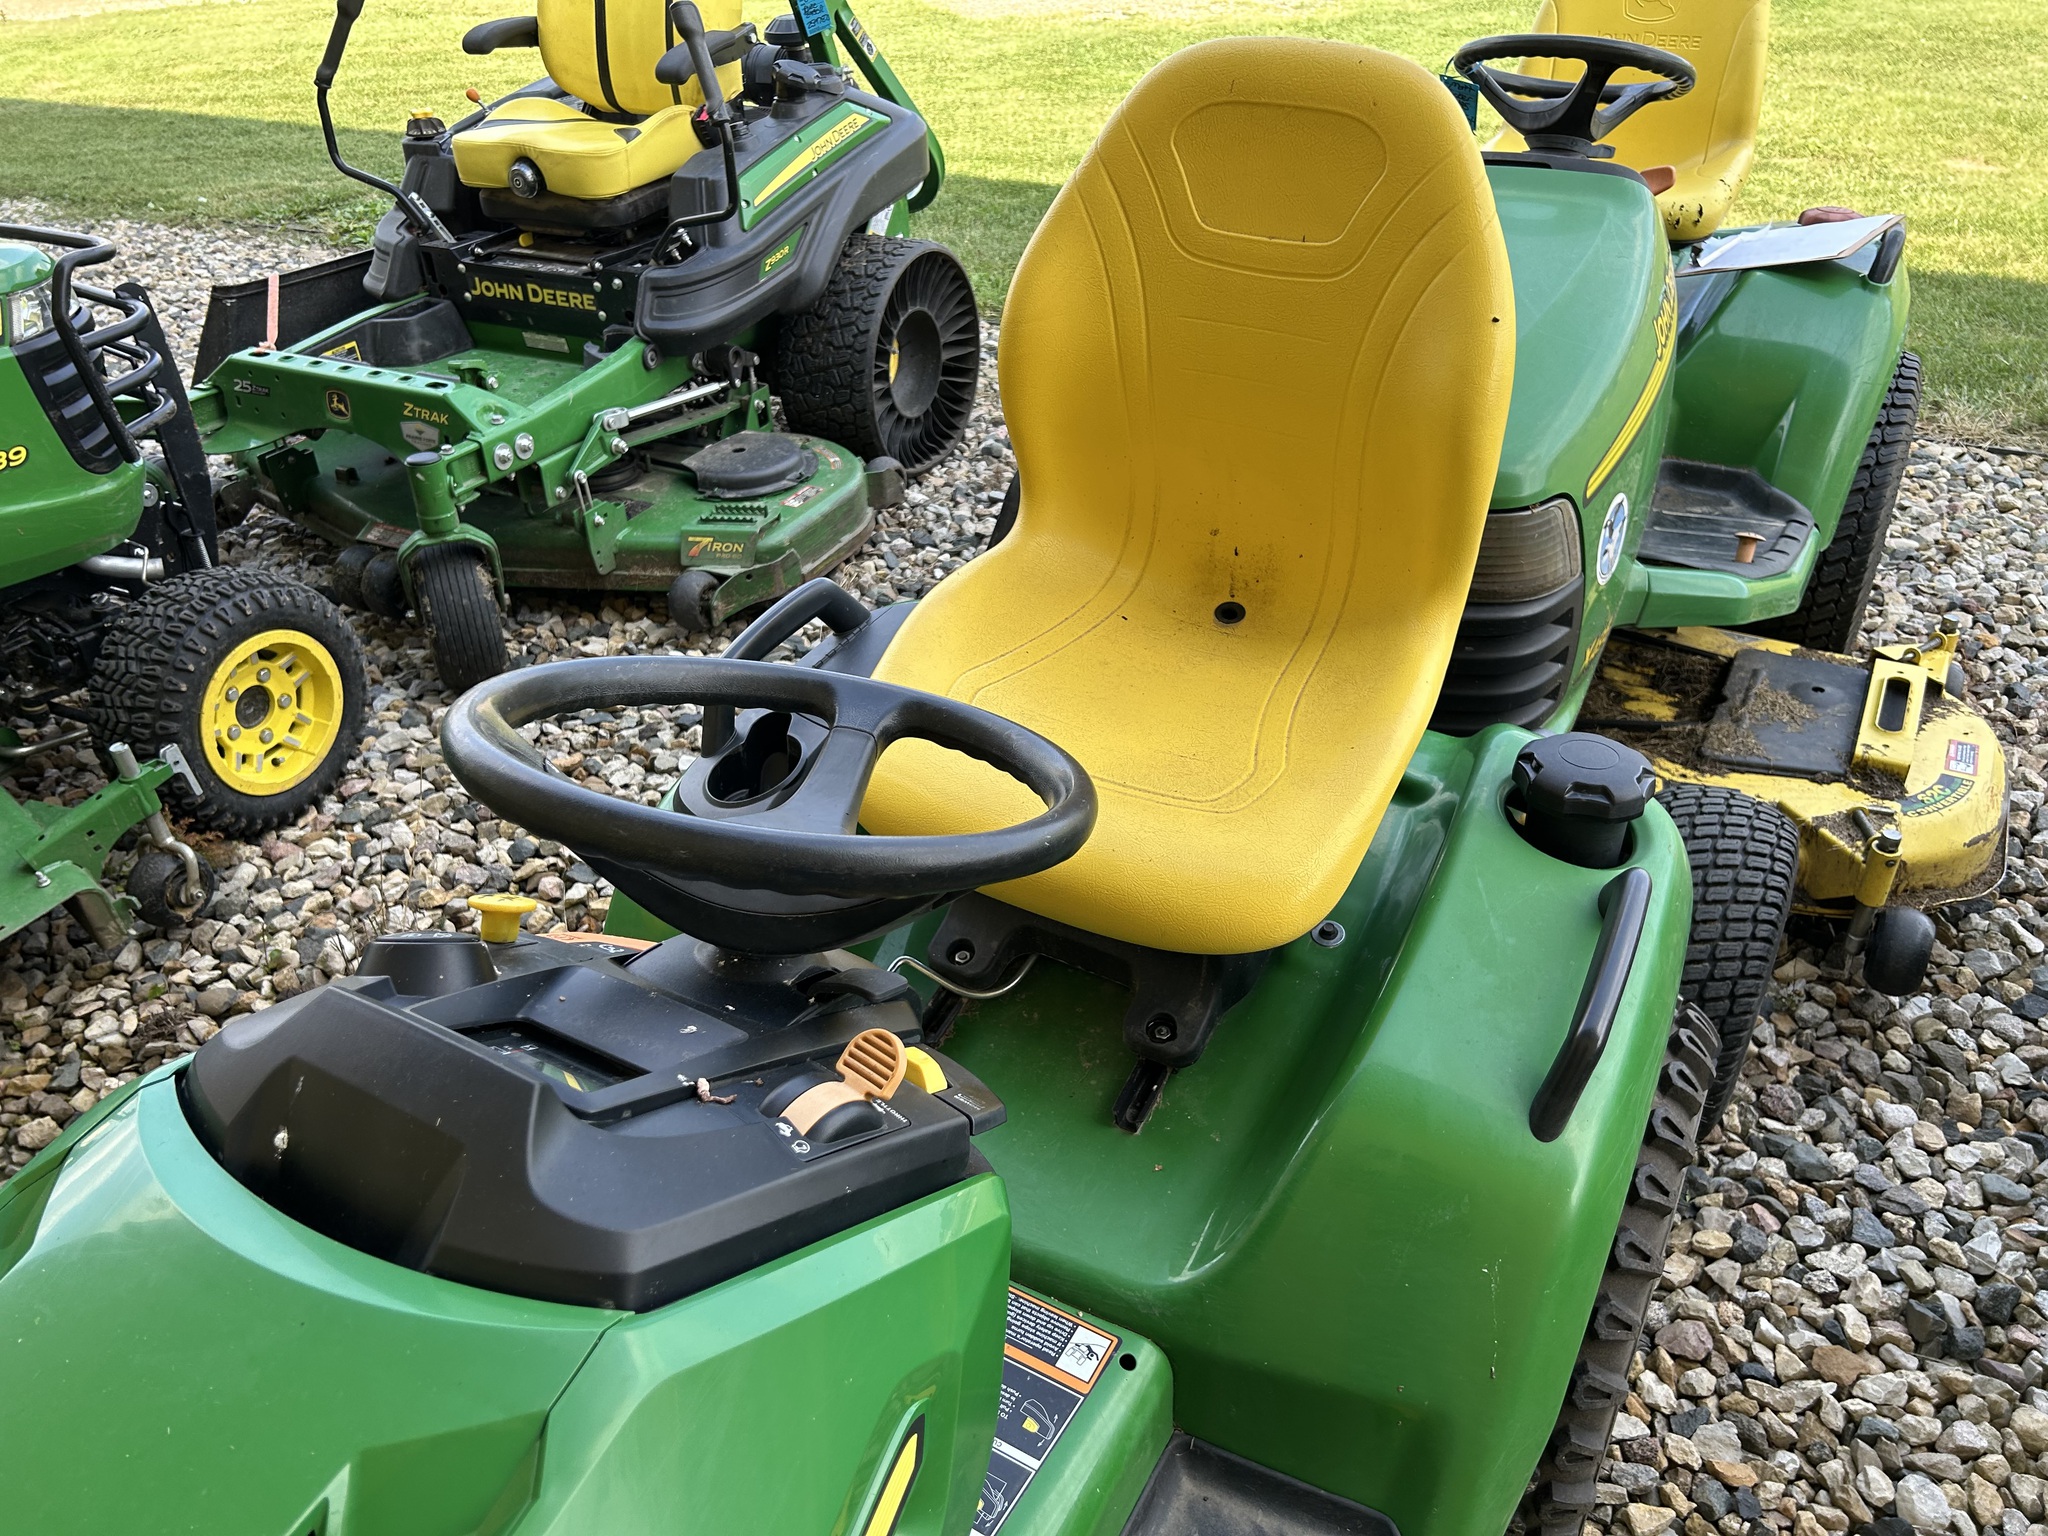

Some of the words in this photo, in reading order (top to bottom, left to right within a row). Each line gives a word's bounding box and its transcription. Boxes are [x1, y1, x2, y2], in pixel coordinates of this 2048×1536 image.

[1641, 30, 1702, 50] DEERE
[811, 136, 834, 161] JOHN
[831, 117, 860, 143] DEERE
[472, 277, 524, 302] JOHN
[527, 283, 597, 311] DEERE
[233, 378, 252, 393] 25
[403, 402, 449, 425] ZTRAK
[1906, 779, 1973, 818] CONVERTIBLE
[875, 1098, 908, 1122] THROTTLE
[1035, 1330, 1057, 1345] machine
[1043, 1341, 1059, 1352] Avoid
[1041, 1346, 1056, 1357] Read
[999, 1411, 1009, 1420] TO
